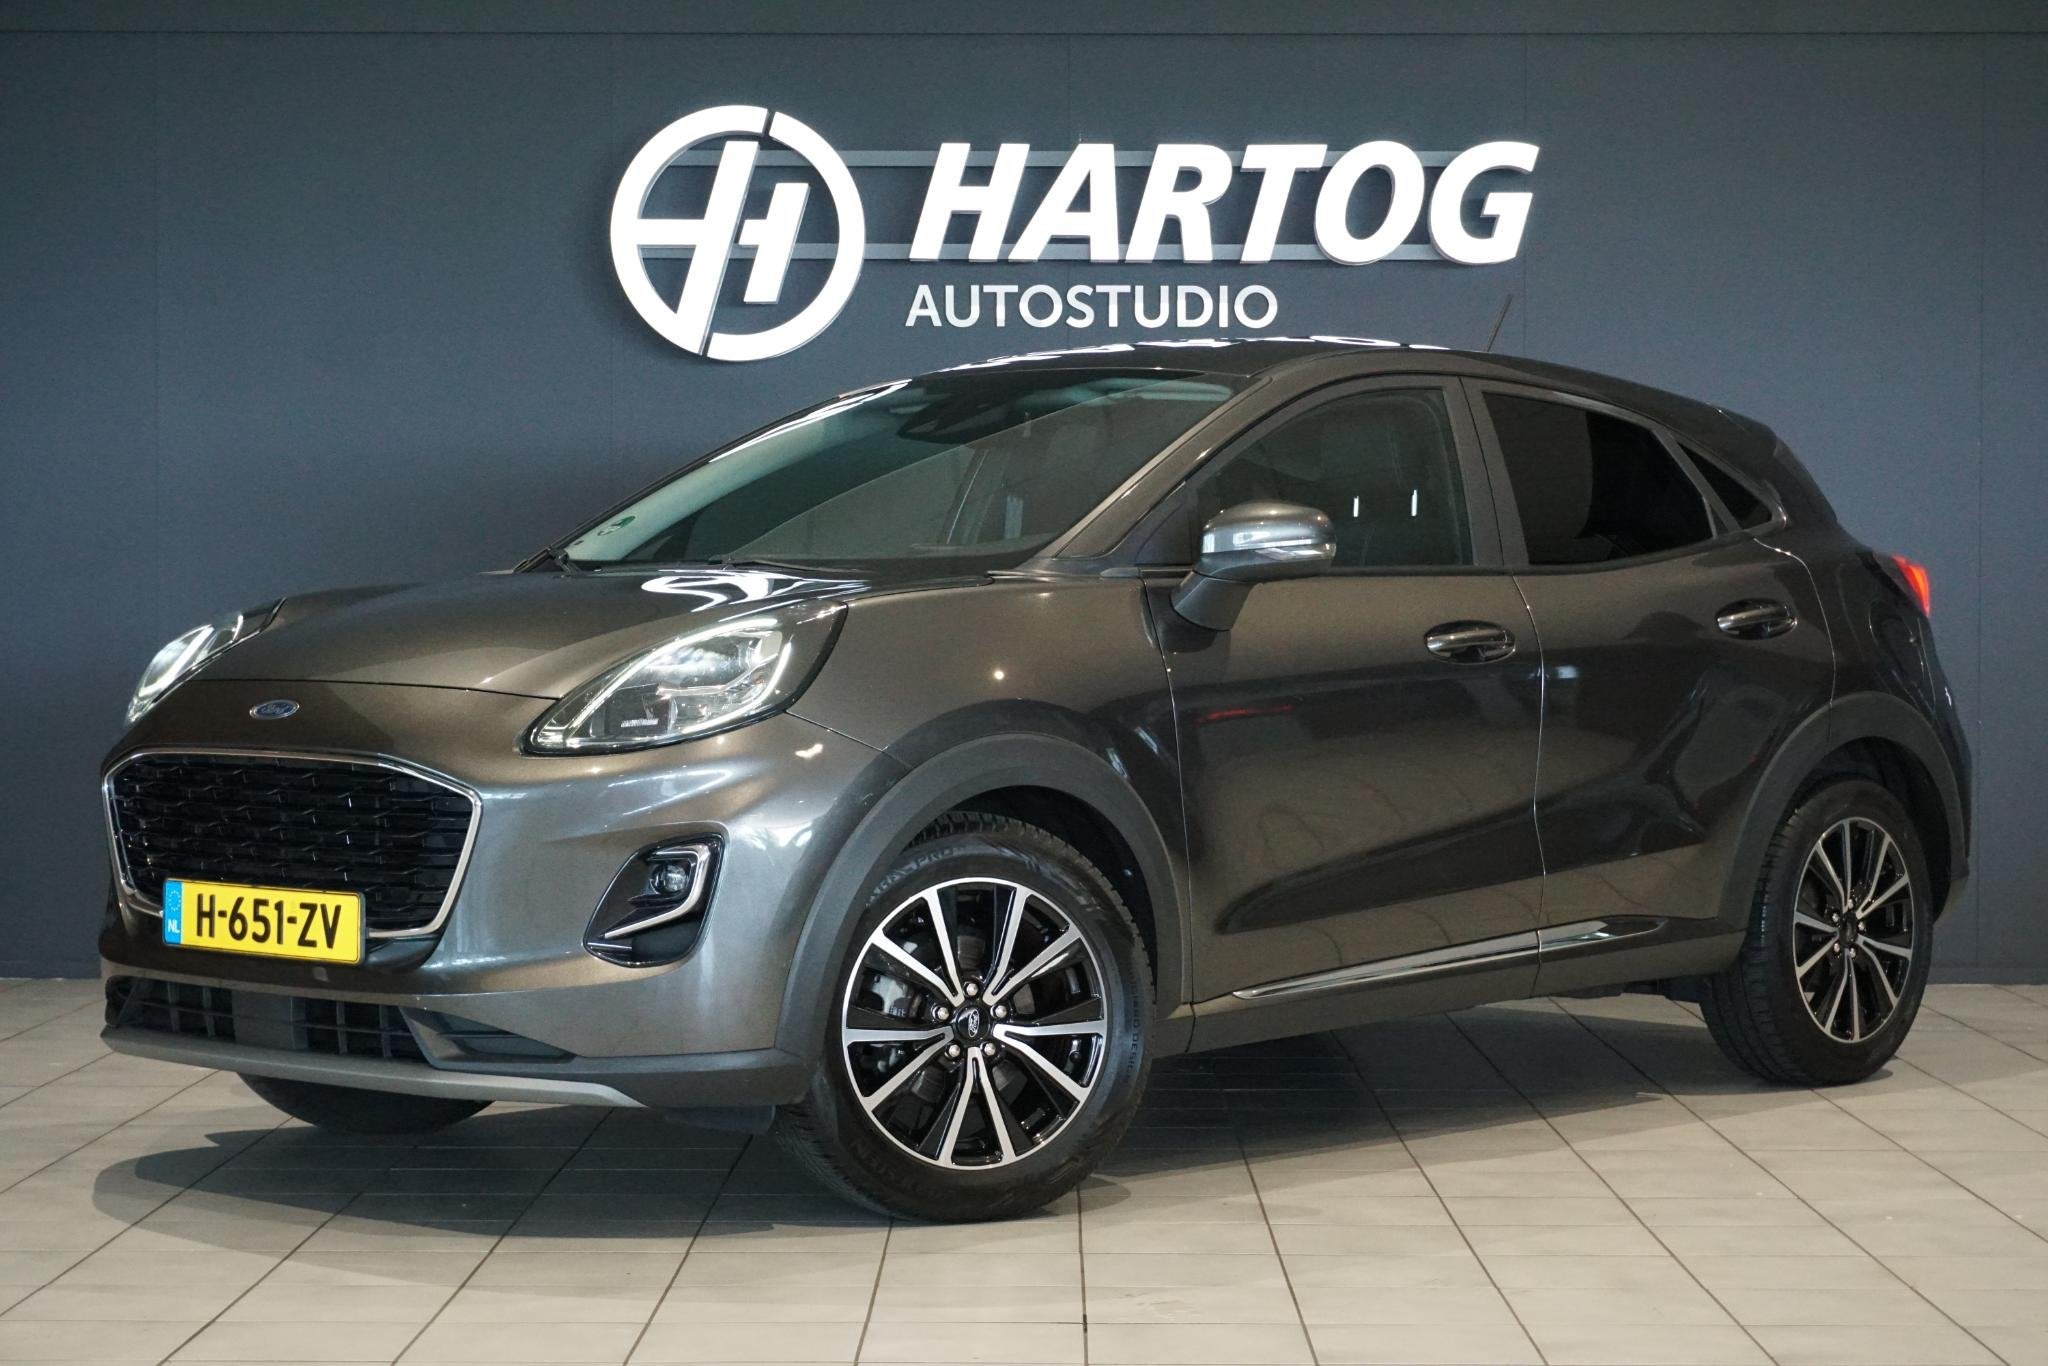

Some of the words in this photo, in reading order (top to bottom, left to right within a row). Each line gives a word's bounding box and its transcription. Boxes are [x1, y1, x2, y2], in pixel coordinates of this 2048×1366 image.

[910, 139, 1540, 266] HARTOG
[904, 284, 1279, 330] AUTOSTUDIO
[167, 918, 181, 934] NL
[196, 893, 342, 949] H-651-ZV
